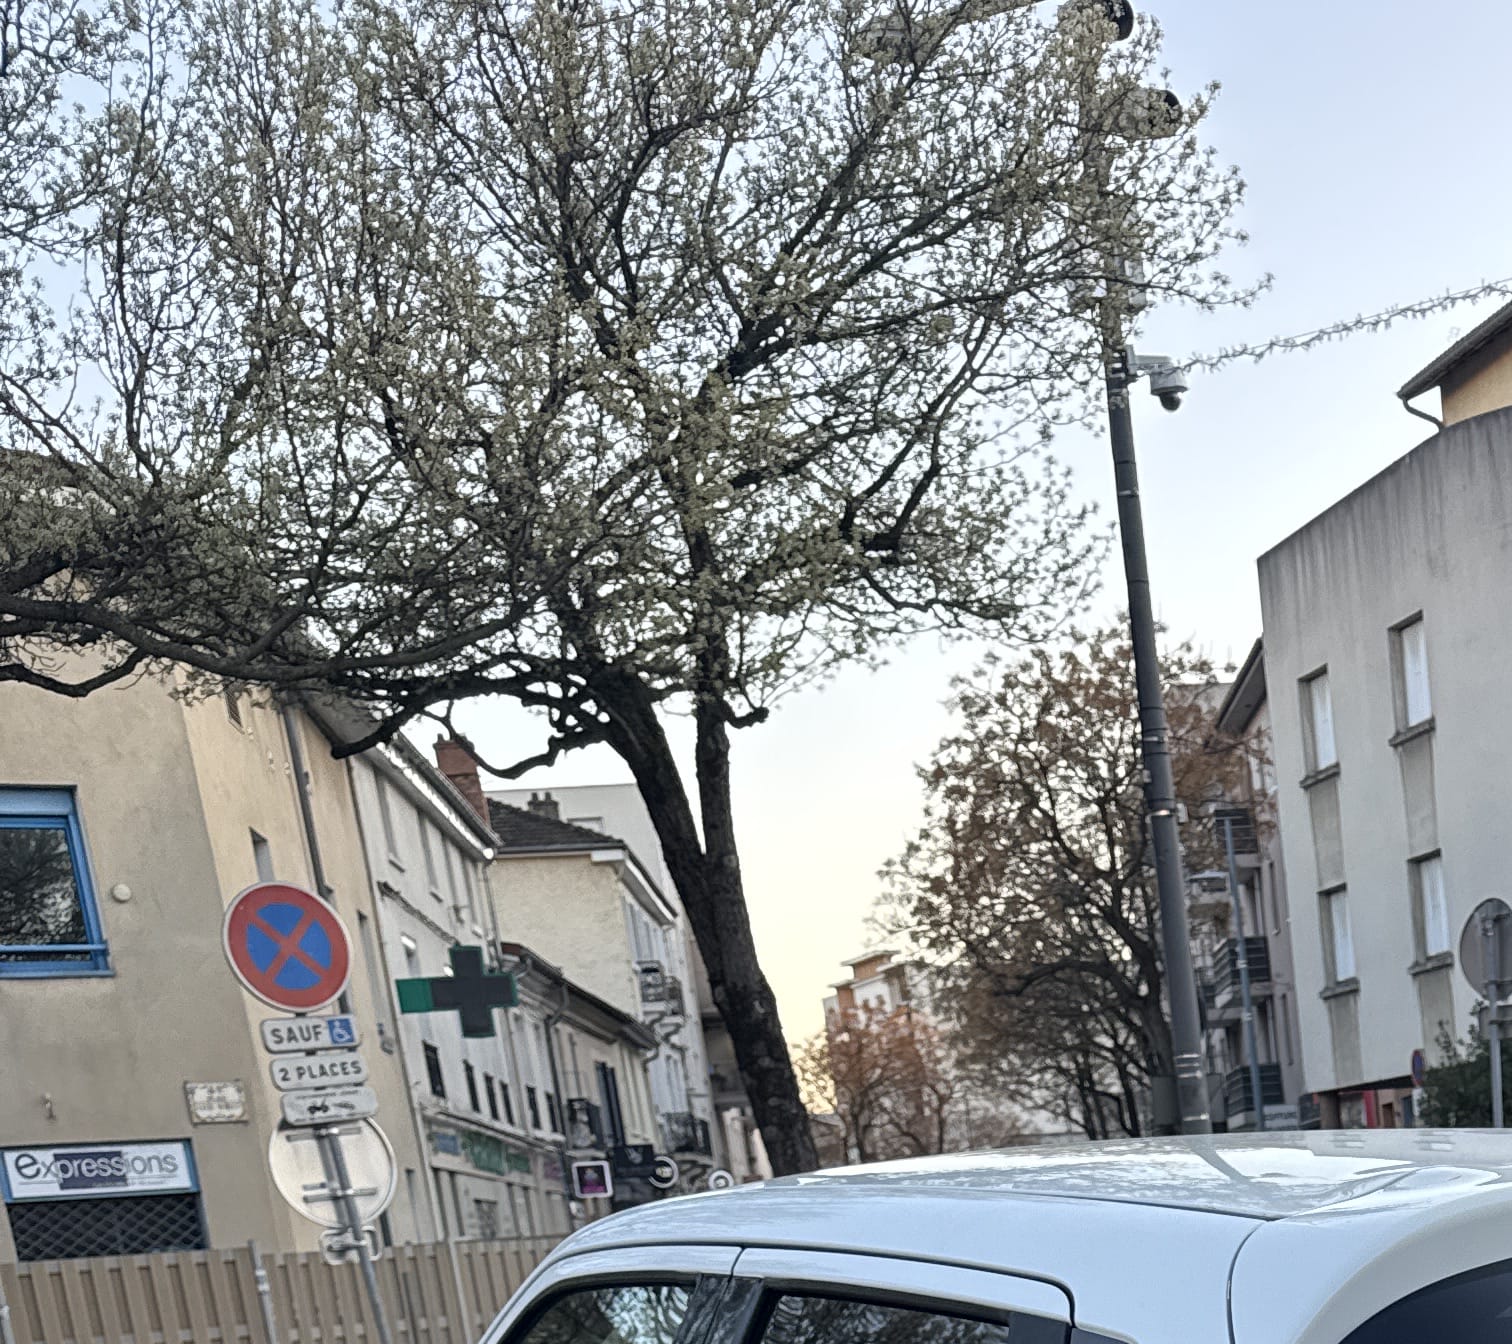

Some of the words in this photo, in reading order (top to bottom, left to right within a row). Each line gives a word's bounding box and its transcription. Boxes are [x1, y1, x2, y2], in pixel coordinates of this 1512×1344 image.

[270, 1024, 322, 1044] SAUF
[279, 1068, 291, 1081] 2
[296, 1060, 363, 1080] PLACES
[15, 1153, 178, 1184] expressions
